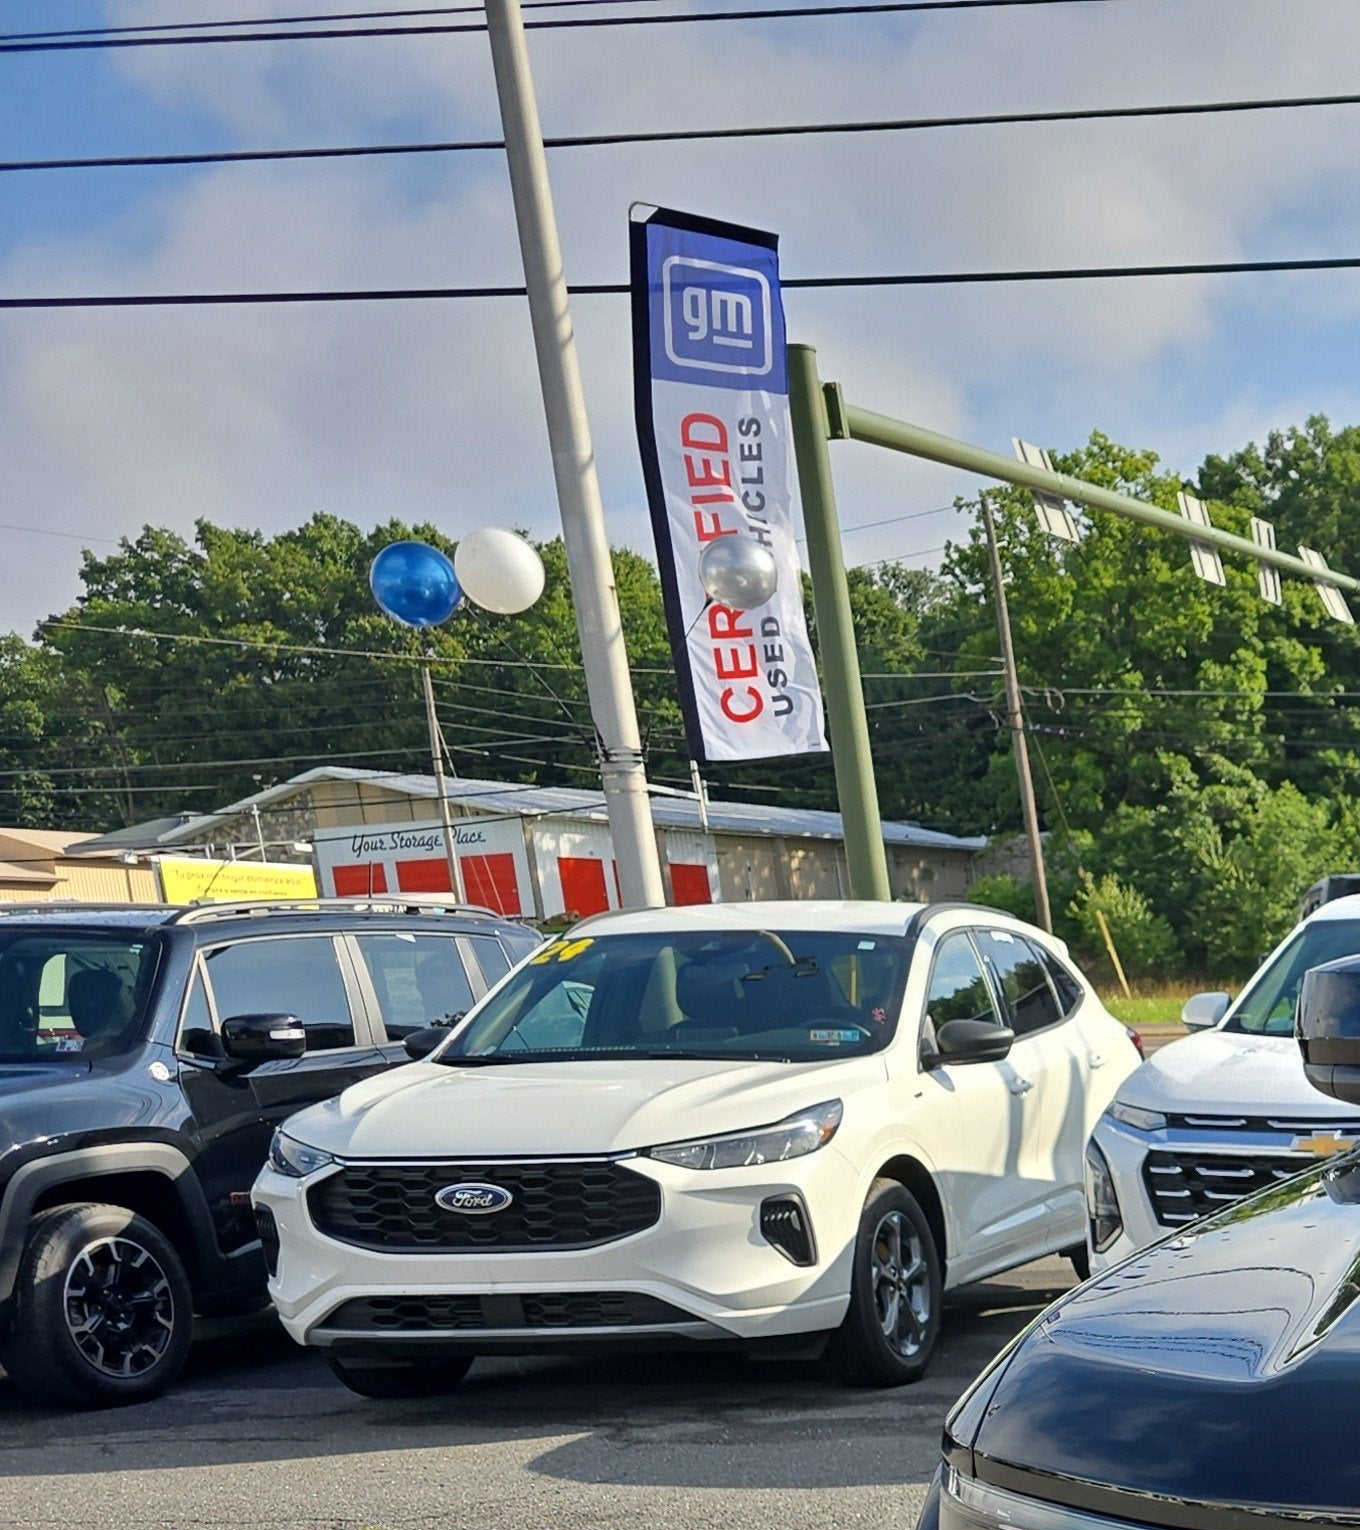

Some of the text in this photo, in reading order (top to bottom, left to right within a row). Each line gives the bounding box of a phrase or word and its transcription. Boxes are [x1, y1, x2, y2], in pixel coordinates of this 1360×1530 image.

[682, 286, 753, 349] gm
[681, 412, 764, 723] CERFIED
[738, 417, 794, 717] USED HICLES
[351, 833, 387, 858] Your
[389, 831, 443, 851] Storage
[452, 1189, 494, 1207] Ford
